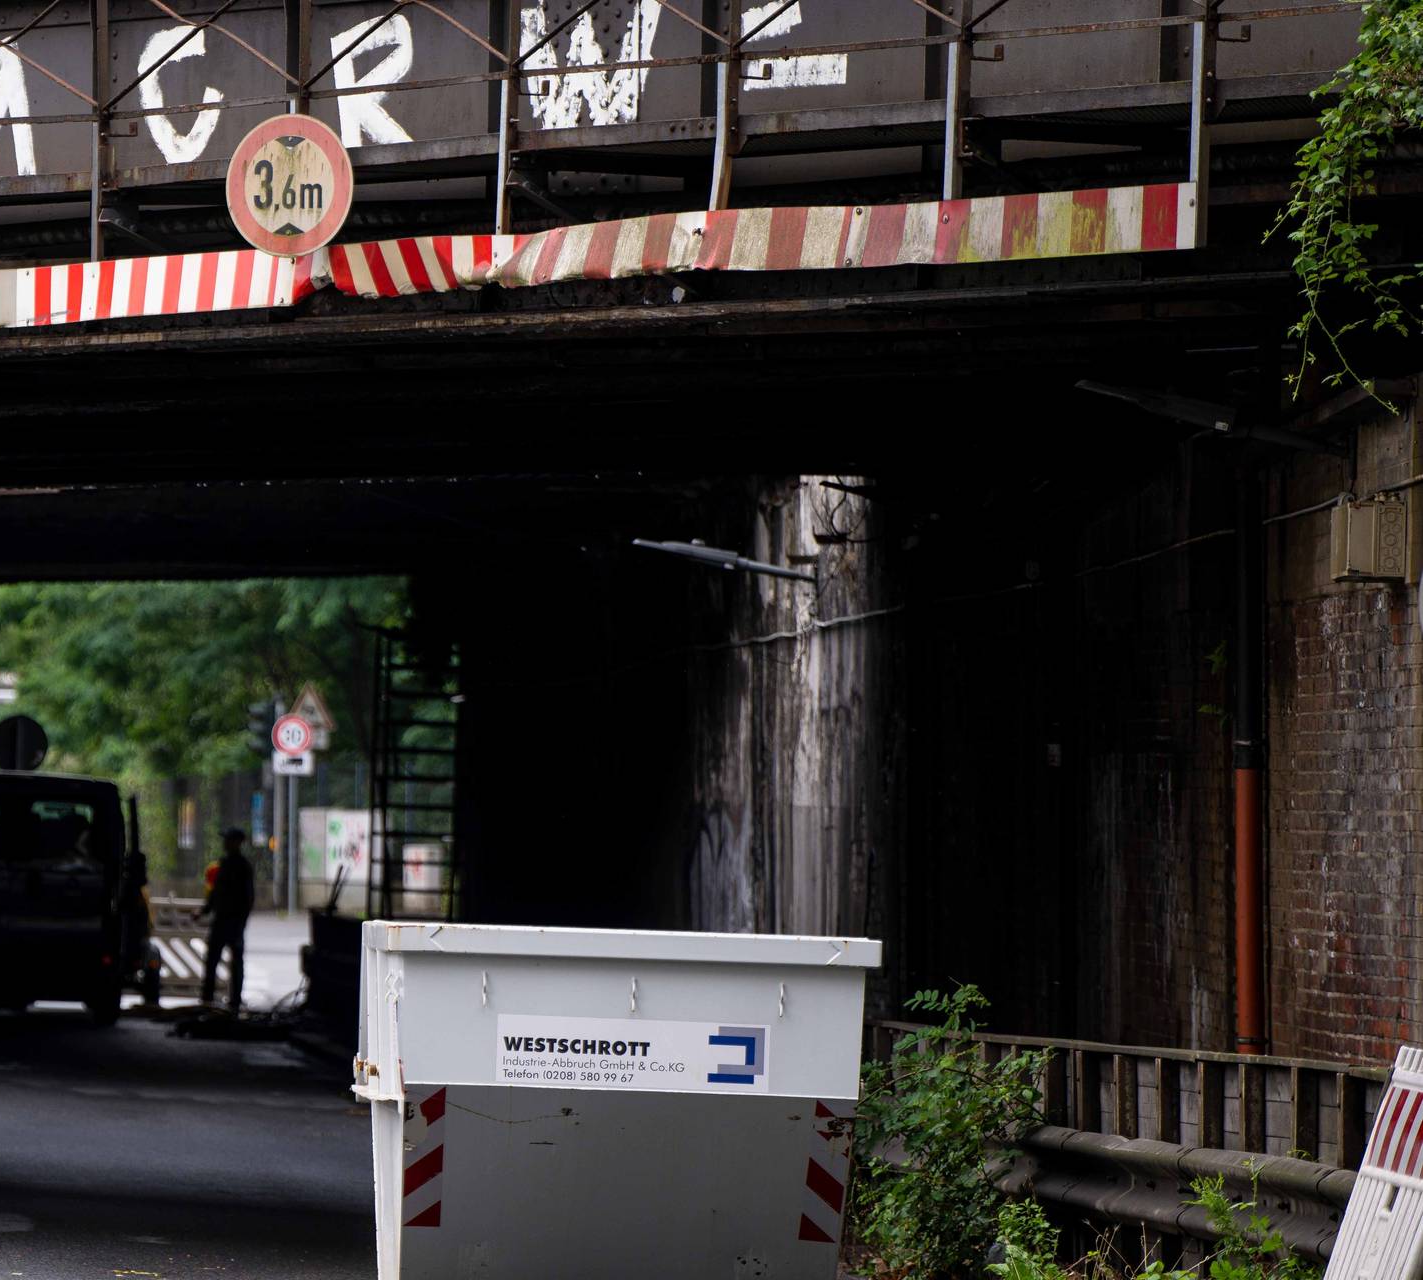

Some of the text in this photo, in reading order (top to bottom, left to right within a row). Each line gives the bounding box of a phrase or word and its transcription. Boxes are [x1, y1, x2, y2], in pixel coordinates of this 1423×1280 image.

[503, 1036, 651, 1057] WESTSCHROTT
[503, 1056, 685, 1072] Industrie-Abbruch GmbH & Co.KG
[503, 1068, 634, 1083] Telefon (0208) 580 99 67
